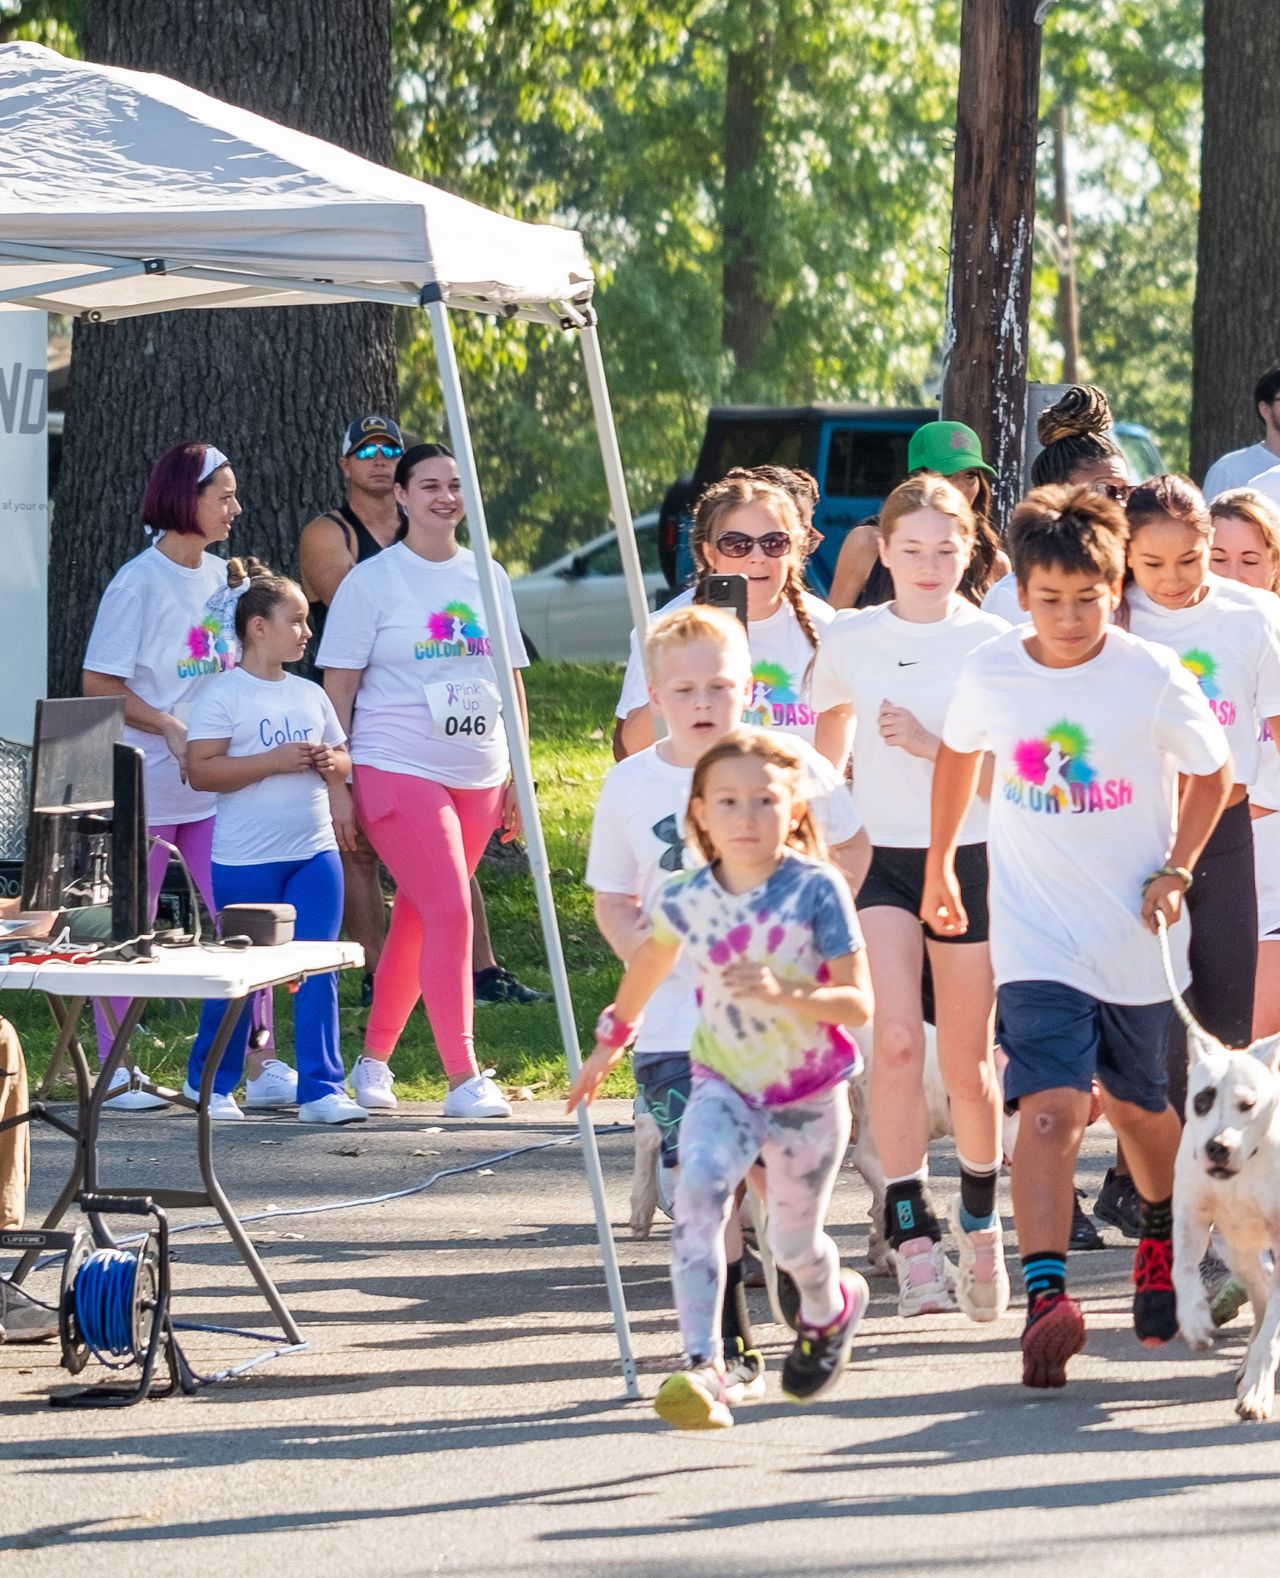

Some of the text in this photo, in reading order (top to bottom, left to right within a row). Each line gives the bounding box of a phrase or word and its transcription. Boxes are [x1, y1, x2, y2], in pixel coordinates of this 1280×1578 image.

[466, 637, 492, 656] DAS
[455, 682, 481, 696] Pink
[462, 699, 480, 713] Up
[445, 715, 486, 736] 046
[1069, 777, 1134, 814] DASH
